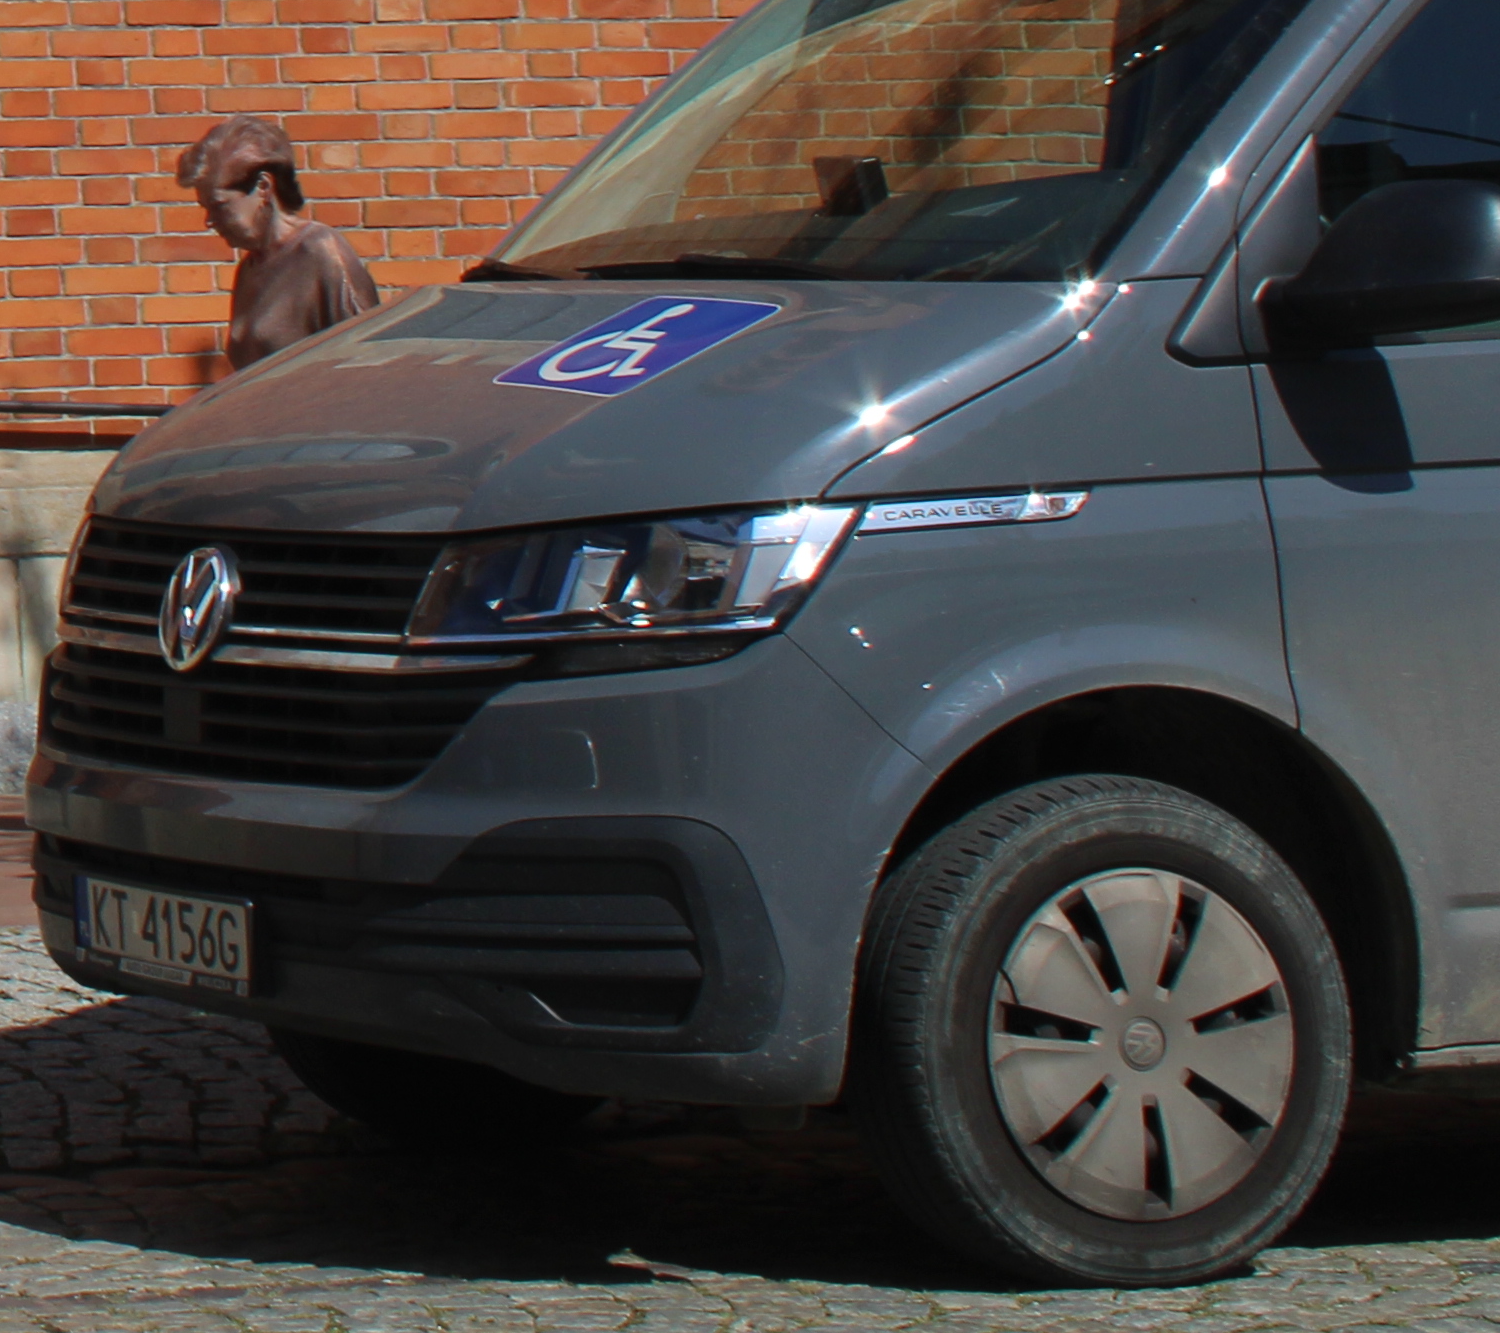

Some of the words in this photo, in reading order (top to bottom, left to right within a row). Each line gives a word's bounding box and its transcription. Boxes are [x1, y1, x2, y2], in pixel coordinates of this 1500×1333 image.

[882, 502, 1004, 522] CARAVELLE
[90, 885, 129, 951] KT
[140, 893, 241, 973] 4156G
